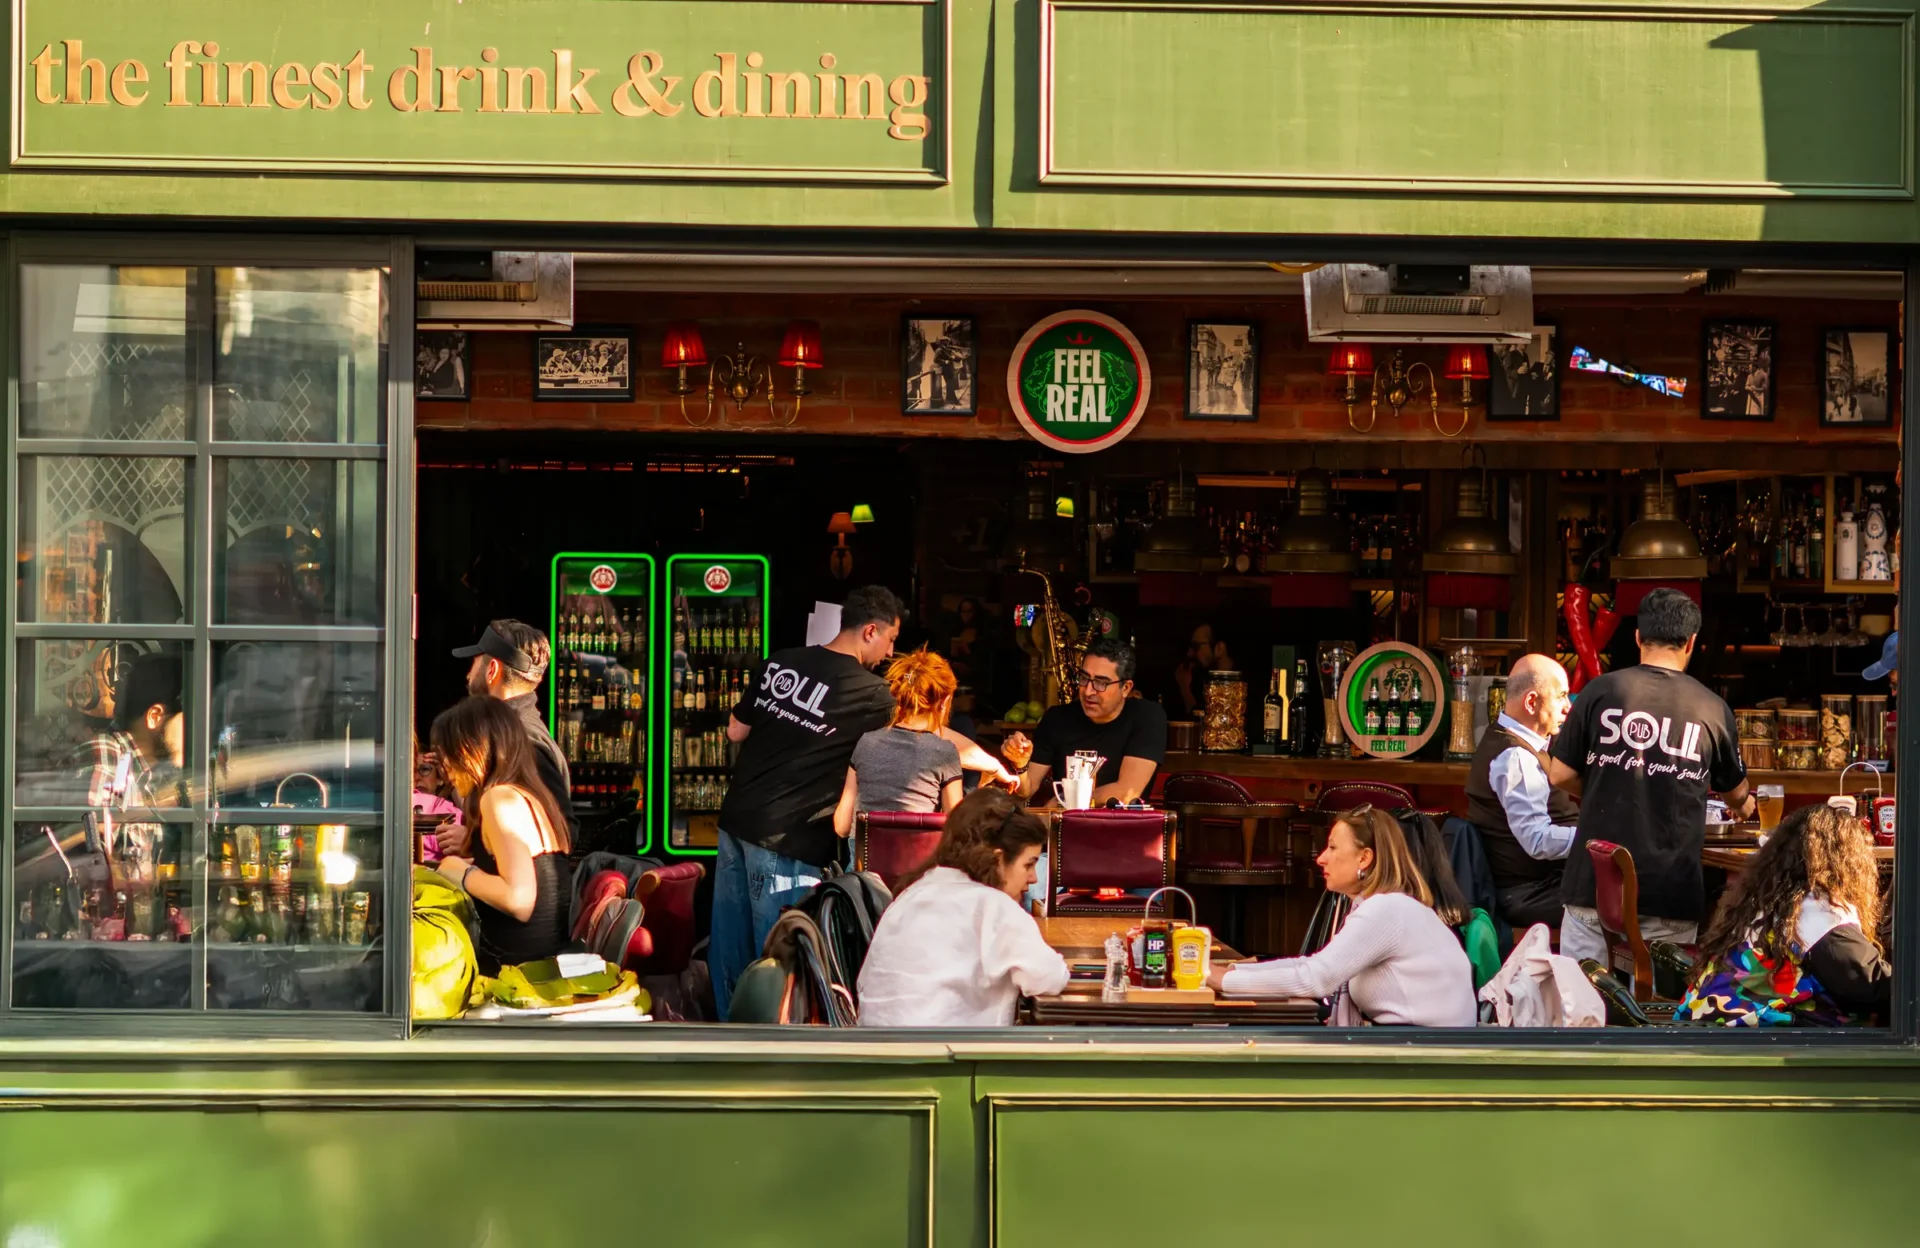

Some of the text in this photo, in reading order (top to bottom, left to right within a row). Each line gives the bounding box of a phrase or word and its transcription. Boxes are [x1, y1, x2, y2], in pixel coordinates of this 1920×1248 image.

[30, 40, 932, 141] the finest drink & dining
[1054, 348, 1105, 384] FEEL
[1046, 384, 1112, 423] REAL
[760, 662, 829, 718] SOUL
[775, 675, 792, 692] PUB
[777, 709, 800, 722] your
[1600, 708, 1701, 762] SOUL
[1629, 721, 1651, 739] PUB
[1371, 740, 1406, 752] FEEL REAL
[1586, 750, 1597, 764] is
[1599, 750, 1627, 767] good
[1624, 757, 1646, 770] for
[1648, 761, 1679, 776] your
[1147, 940, 1165, 950] HP
